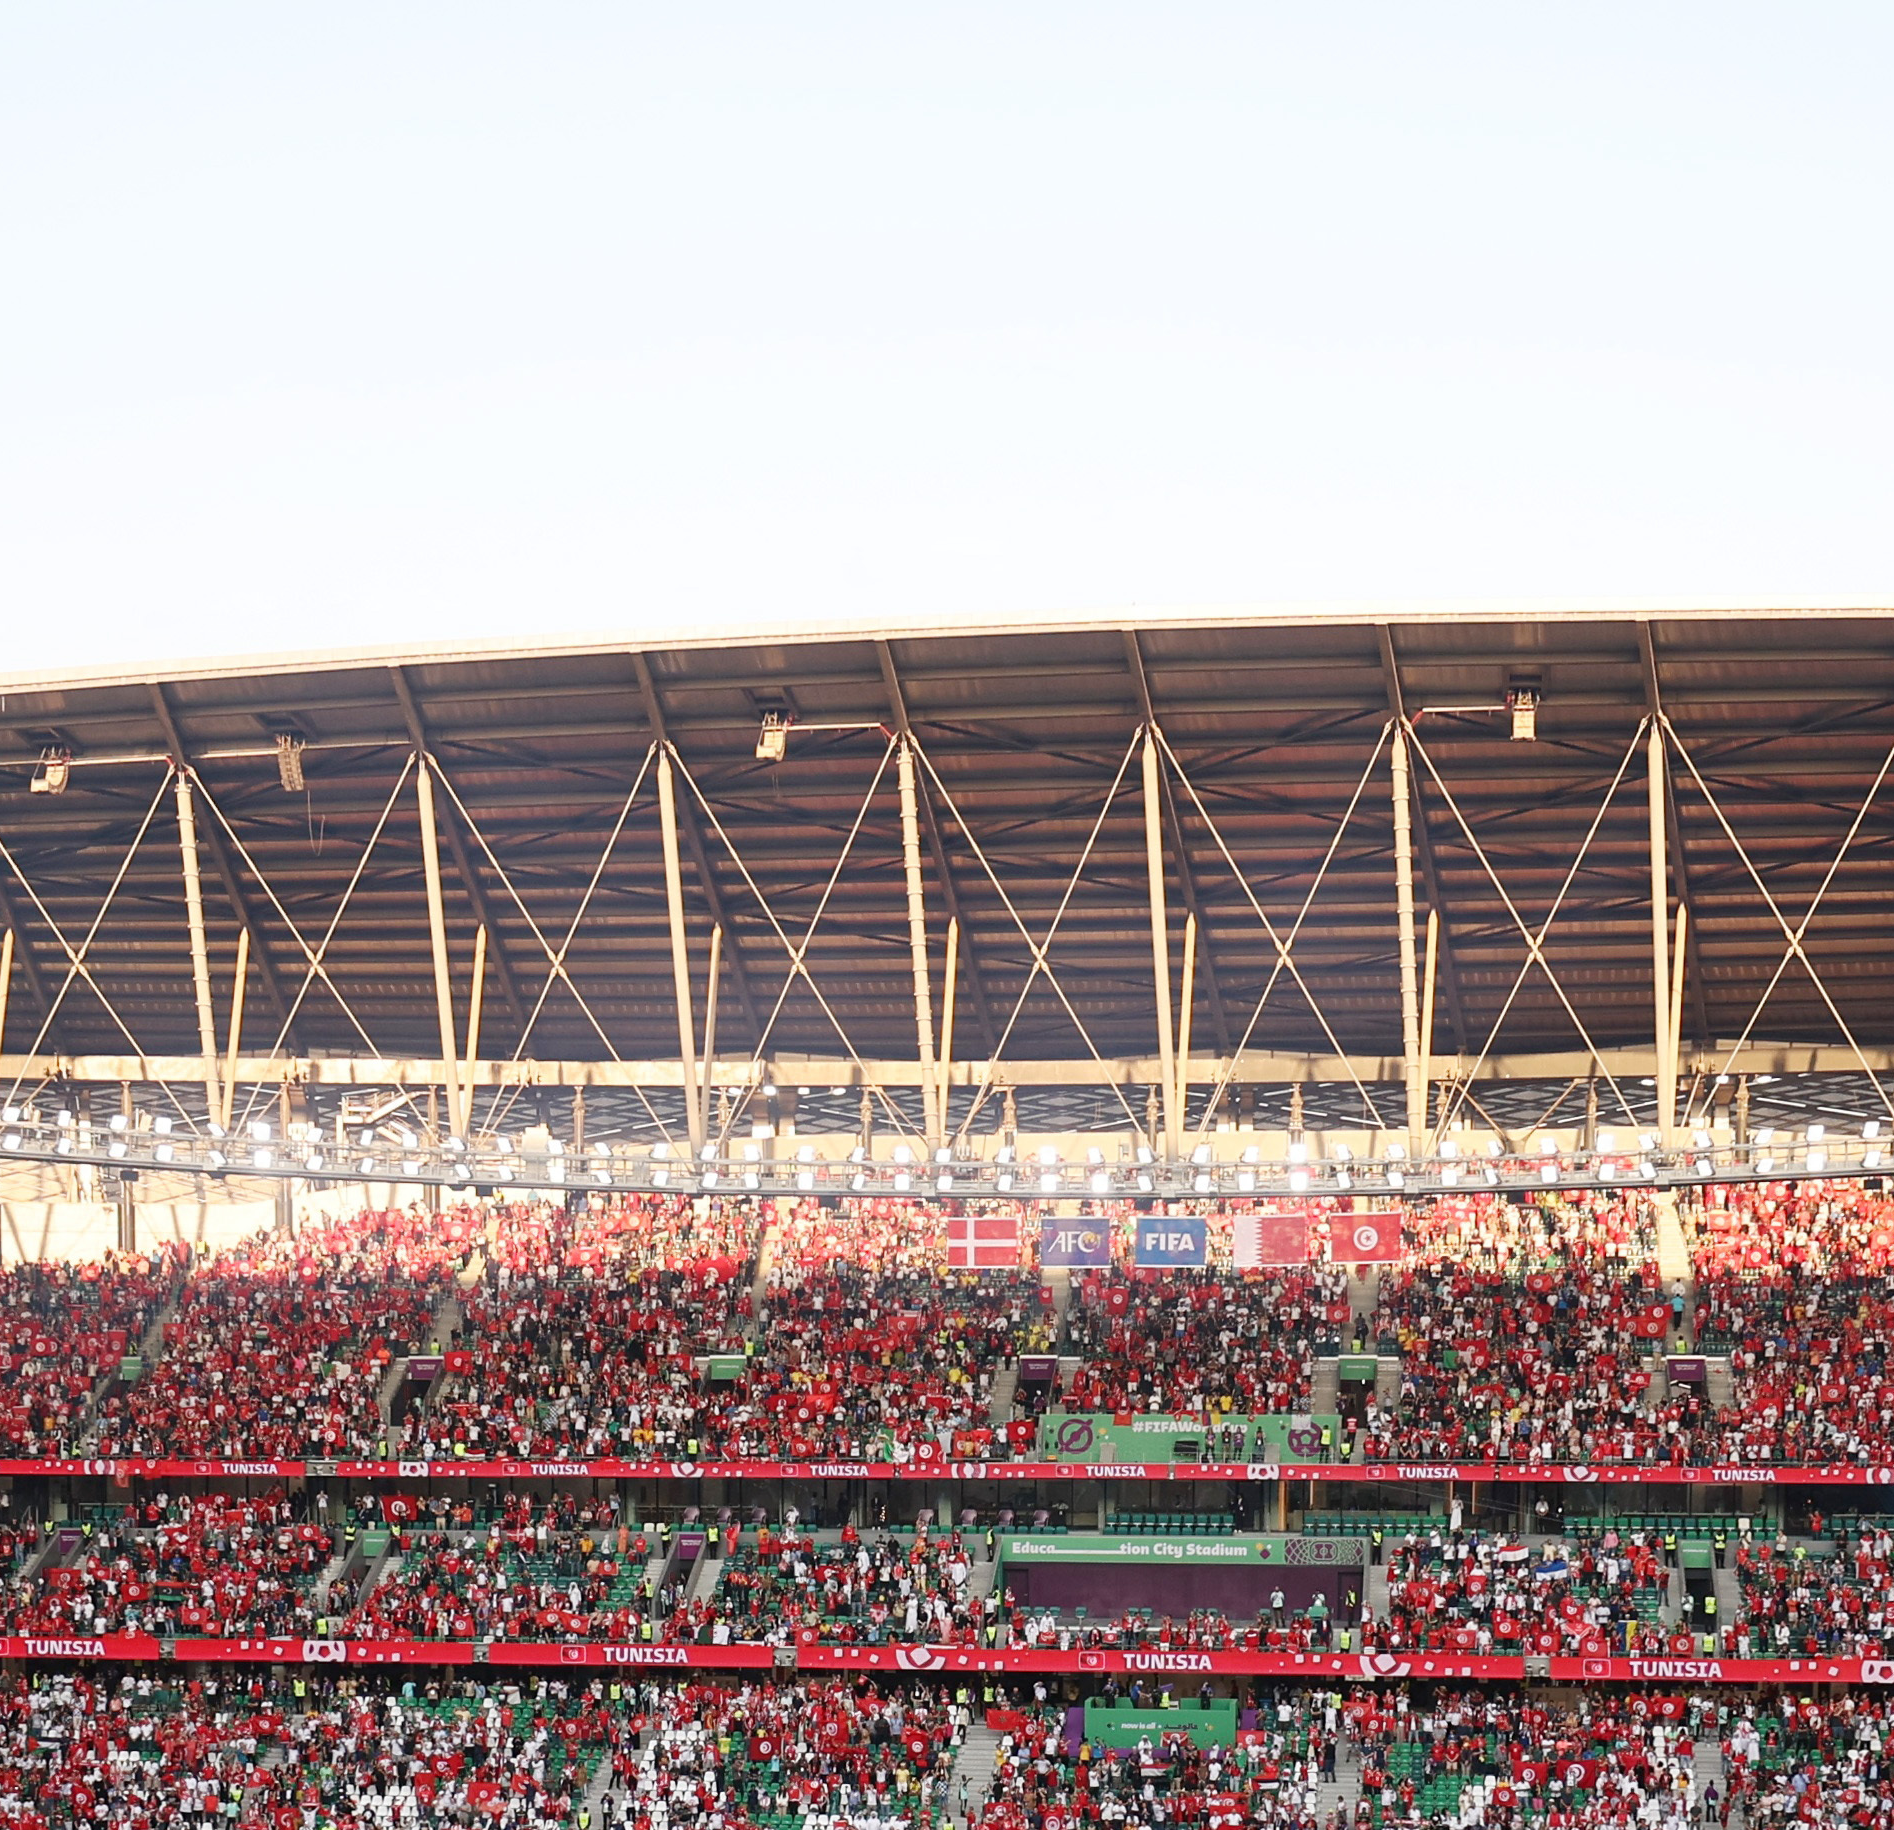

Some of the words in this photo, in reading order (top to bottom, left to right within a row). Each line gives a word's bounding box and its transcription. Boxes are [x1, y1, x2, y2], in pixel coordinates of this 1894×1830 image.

[1048, 1231, 1095, 1253] AFC
[1146, 1233, 1194, 1252] FIFA
[222, 1464, 277, 1474] TUNISIA
[531, 1464, 588, 1475] TUNISIA
[810, 1462, 868, 1476] TUNISIA
[810, 1465, 868, 1476] TUNISIA
[1086, 1466, 1145, 1476] TUNISIA
[1397, 1467, 1459, 1478] TUNISIA
[1713, 1470, 1775, 1481] TUNISIA
[1012, 1541, 1150, 1555] Education
[1153, 1543, 1183, 1558] City
[1186, 1543, 1248, 1557] Stadium
[25, 1640, 105, 1655] TUNISIA
[1123, 1654, 1212, 1670] TUNISIA
[1630, 1661, 1722, 1677] TUNISIA
